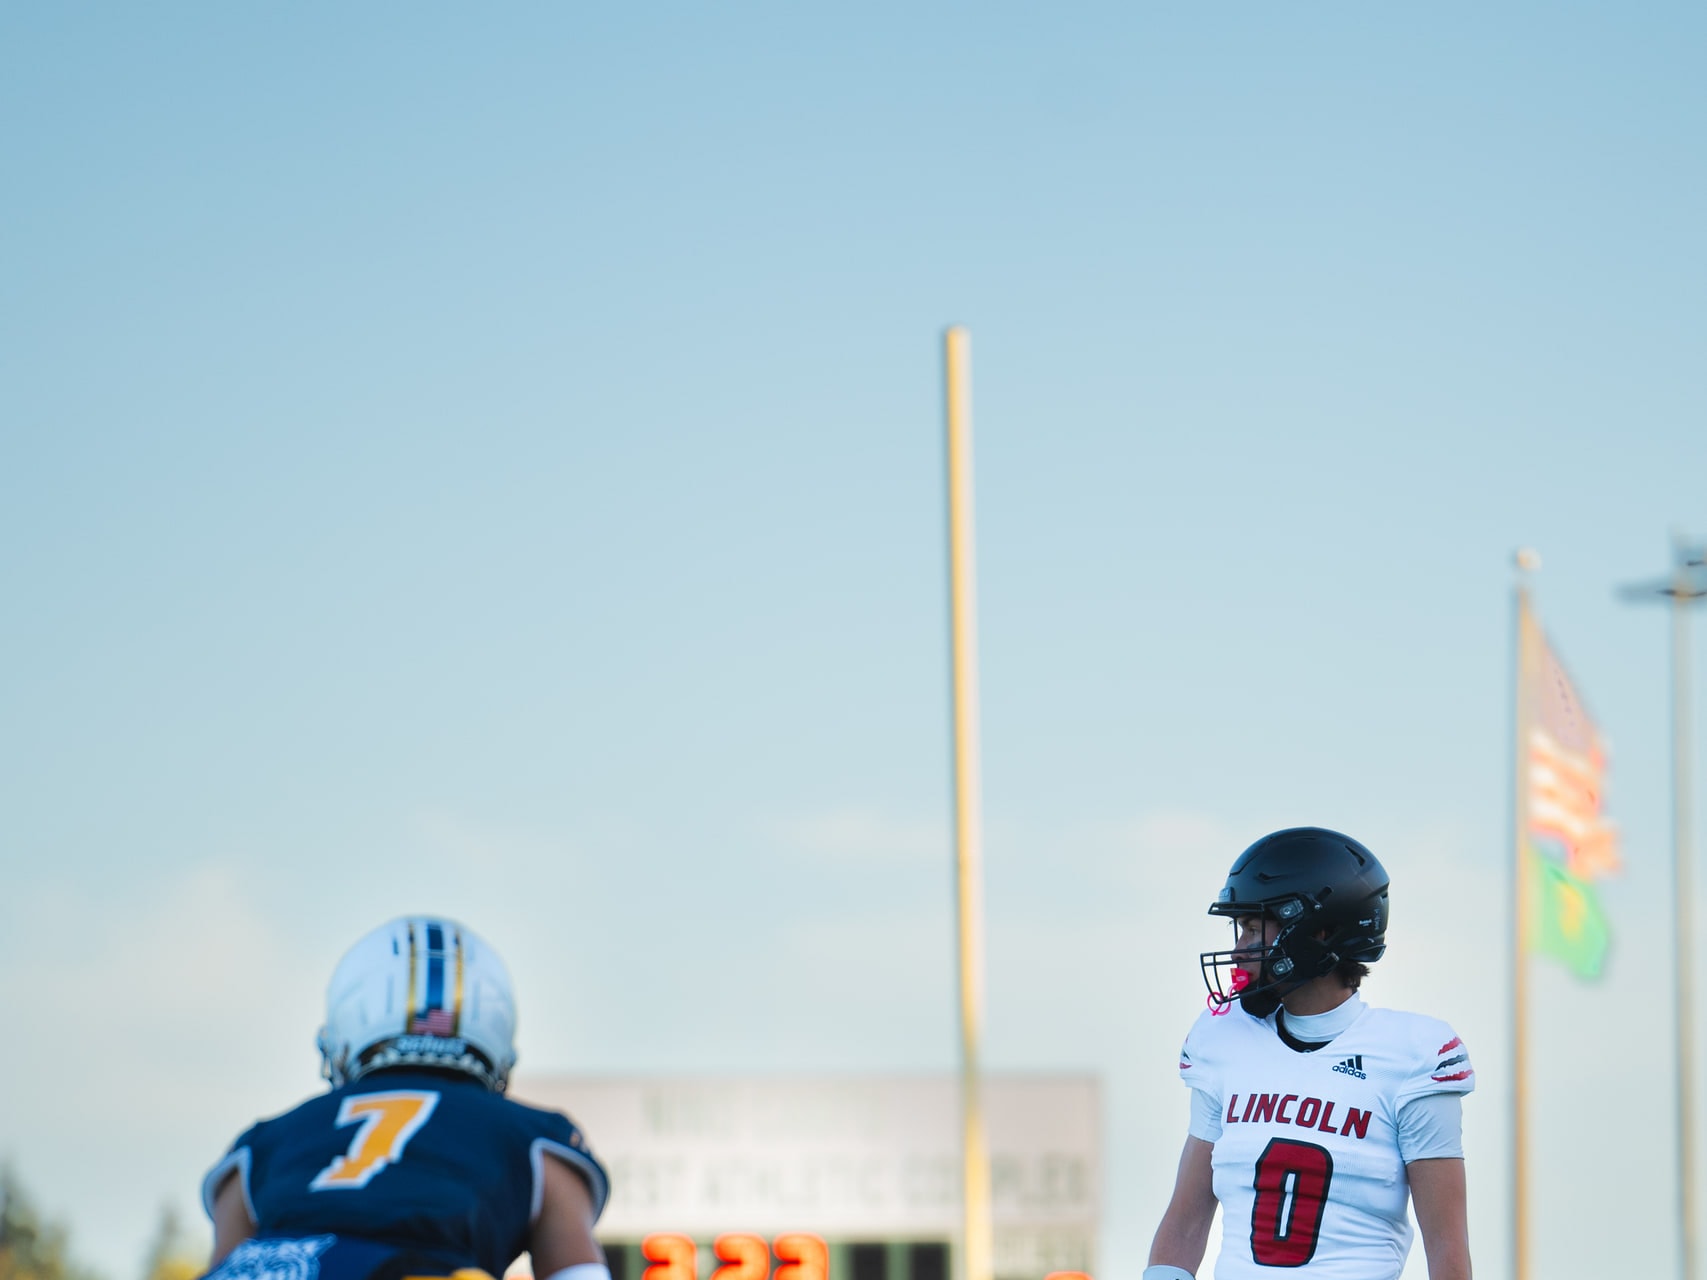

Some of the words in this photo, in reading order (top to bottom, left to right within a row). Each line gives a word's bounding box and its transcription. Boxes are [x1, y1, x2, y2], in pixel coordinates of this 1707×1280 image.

[1332, 1065, 1367, 1080] adidas
[308, 1089, 441, 1192] 7
[1226, 1093, 1372, 1139] LINCOLN
[1250, 1137, 1334, 1267] 0
